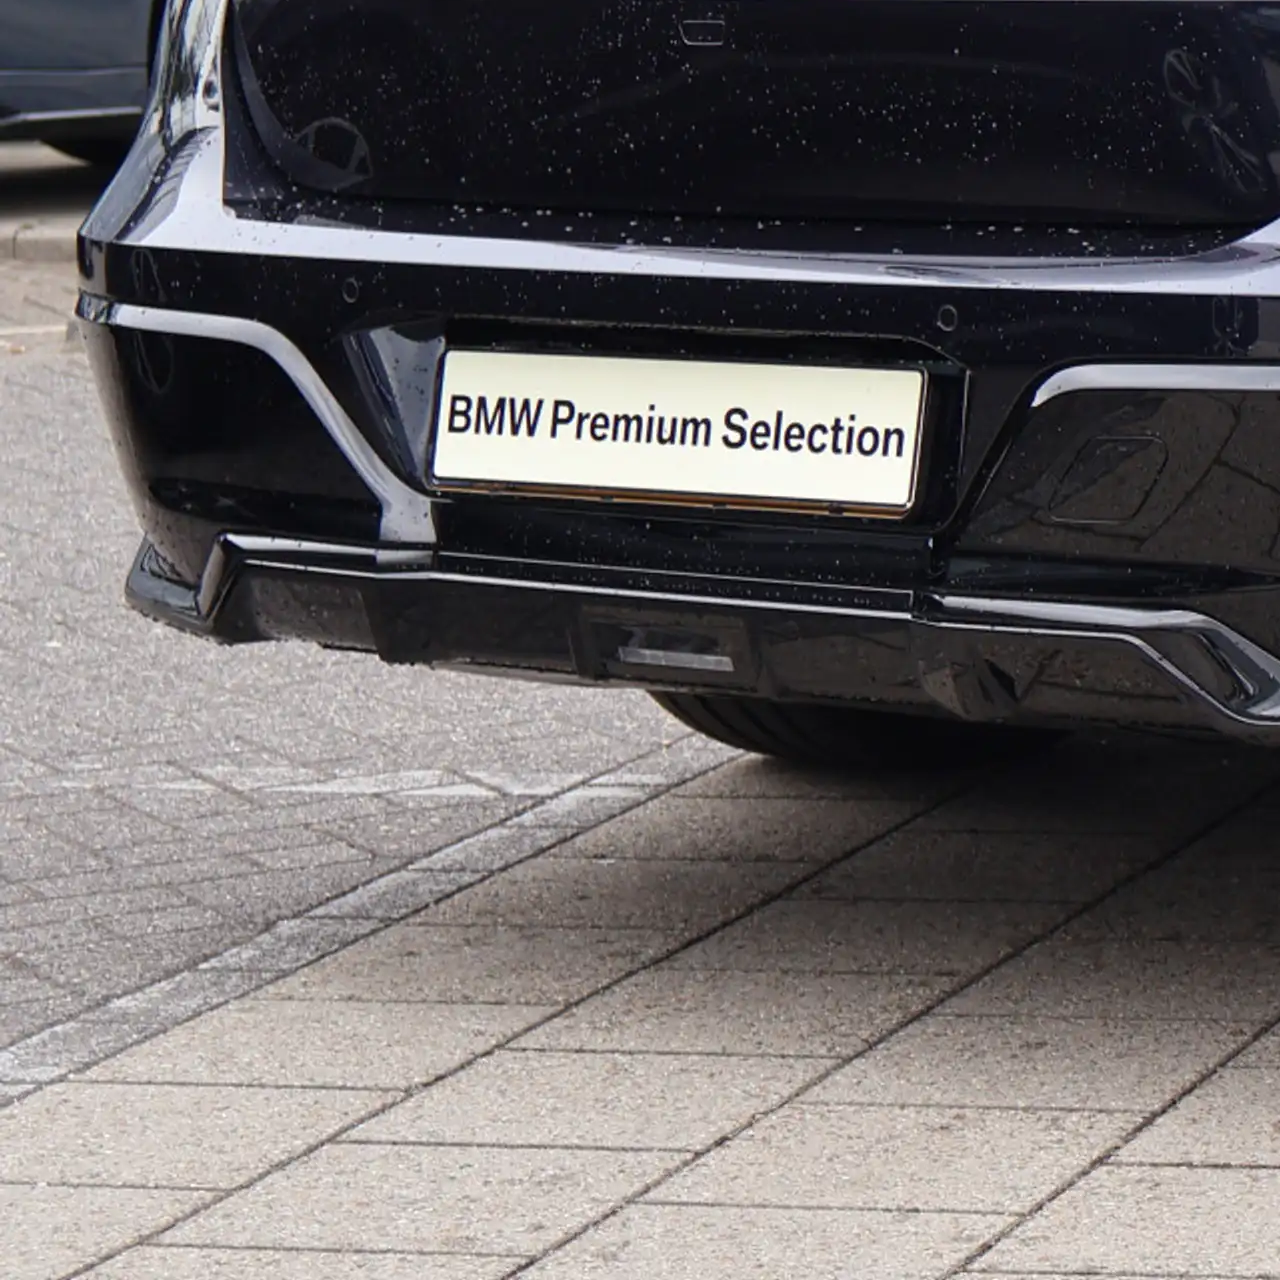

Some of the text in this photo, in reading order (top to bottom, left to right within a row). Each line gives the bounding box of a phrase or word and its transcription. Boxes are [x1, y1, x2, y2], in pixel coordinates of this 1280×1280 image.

[447, 394, 906, 458] BMW Premium Selection
